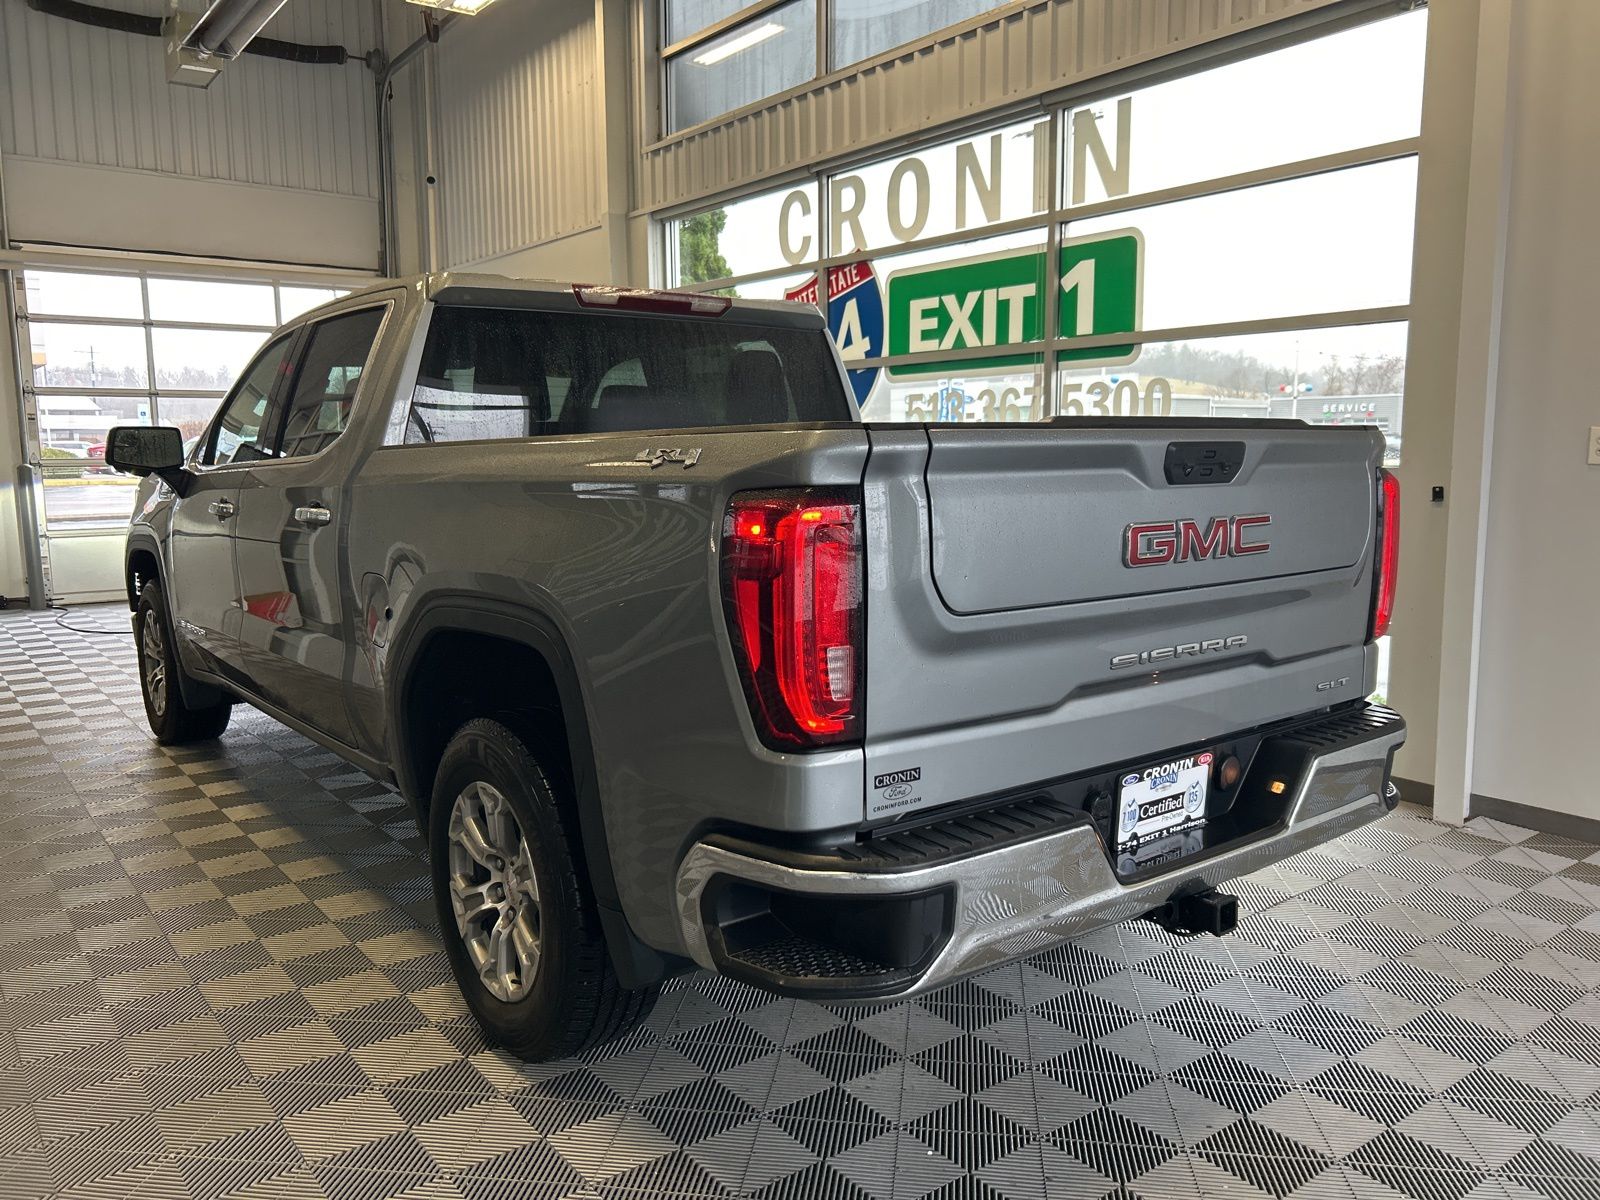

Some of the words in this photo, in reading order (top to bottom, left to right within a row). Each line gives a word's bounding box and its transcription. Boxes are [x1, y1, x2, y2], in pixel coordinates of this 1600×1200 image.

[778, 96, 1132, 266] CRONIN
[909, 283, 1036, 353] EXIT
[1060, 258, 1096, 336] 1
[1322, 402, 1376, 413] SERVICE
[1122, 512, 1272, 568] GMC
[1110, 634, 1248, 670] SIERRA
[1316, 676, 1350, 691] SLT
[875, 769, 920, 787] CRONIN
[1143, 757, 1194, 781] CRONIN
[888, 784, 907, 798] Ford
[872, 797, 922, 813] CRONINFORD.COM
[1140, 794, 1183, 818] Certified
[1118, 839, 1138, 851] I-74
[1140, 831, 1160, 844] EXIT
[1161, 829, 1169, 838] 1
[1169, 818, 1206, 834] Harrison
